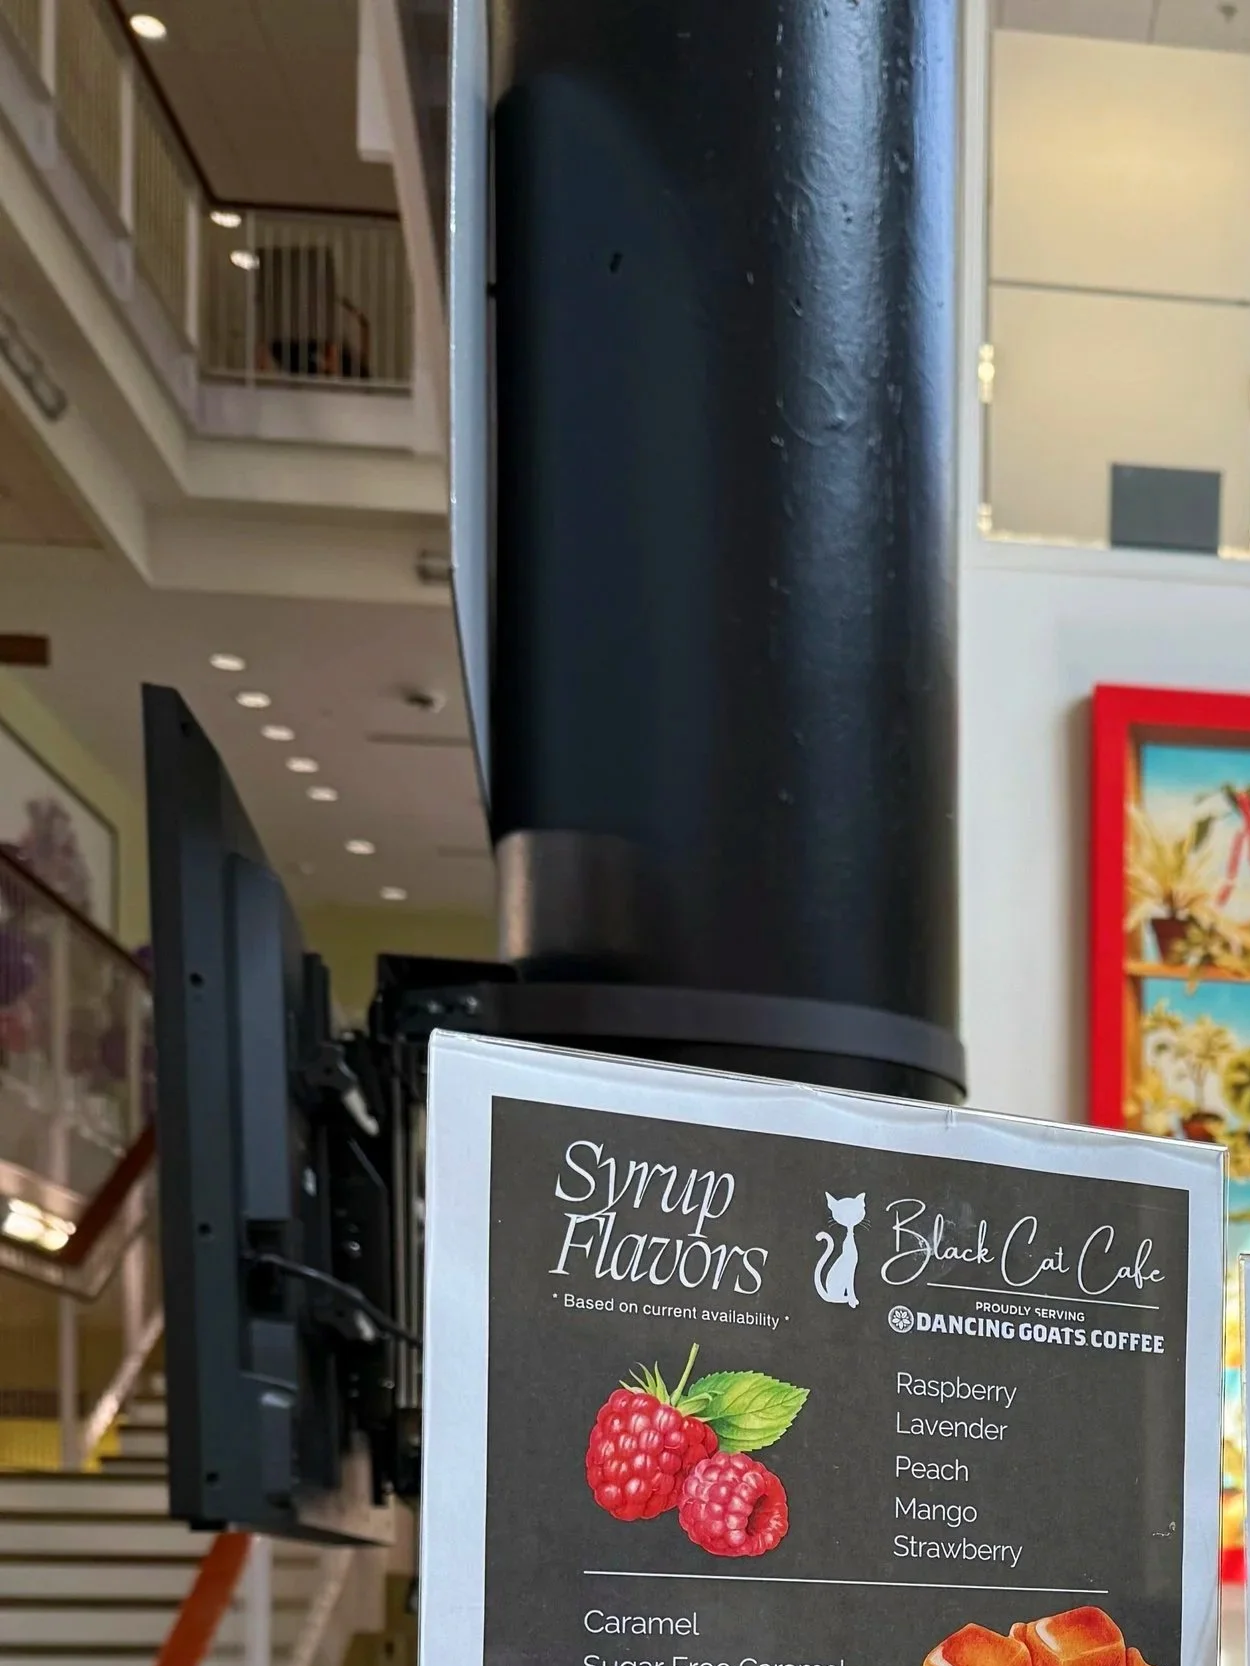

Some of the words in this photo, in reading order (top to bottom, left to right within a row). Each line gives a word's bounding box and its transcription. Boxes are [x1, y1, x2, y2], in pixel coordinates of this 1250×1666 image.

[554, 1140, 735, 1238] Syrup
[548, 1211, 769, 1295] Flavors
[879, 1197, 996, 1287] Black
[1000, 1215, 1071, 1288] Cat
[1076, 1224, 1167, 1296] Cafe
[564, 1293, 614, 1312] Based
[618, 1301, 638, 1314] on
[642, 1304, 697, 1320] current
[701, 1309, 780, 1331] availability
[975, 1301, 1032, 1316] PROUDLY
[1034, 1307, 1085, 1322] SERVING
[916, 1312, 1015, 1340] DANCING
[1018, 1323, 1087, 1347] GOATS
[1090, 1329, 1165, 1354] COFFEE
[897, 1371, 1017, 1409] Raspberry
[896, 1411, 1008, 1441] Lavender
[895, 1455, 969, 1482] Peach
[895, 1496, 978, 1528] Mango
[893, 1534, 1023, 1568] Strawberry
[584, 1609, 700, 1636] Caramel
